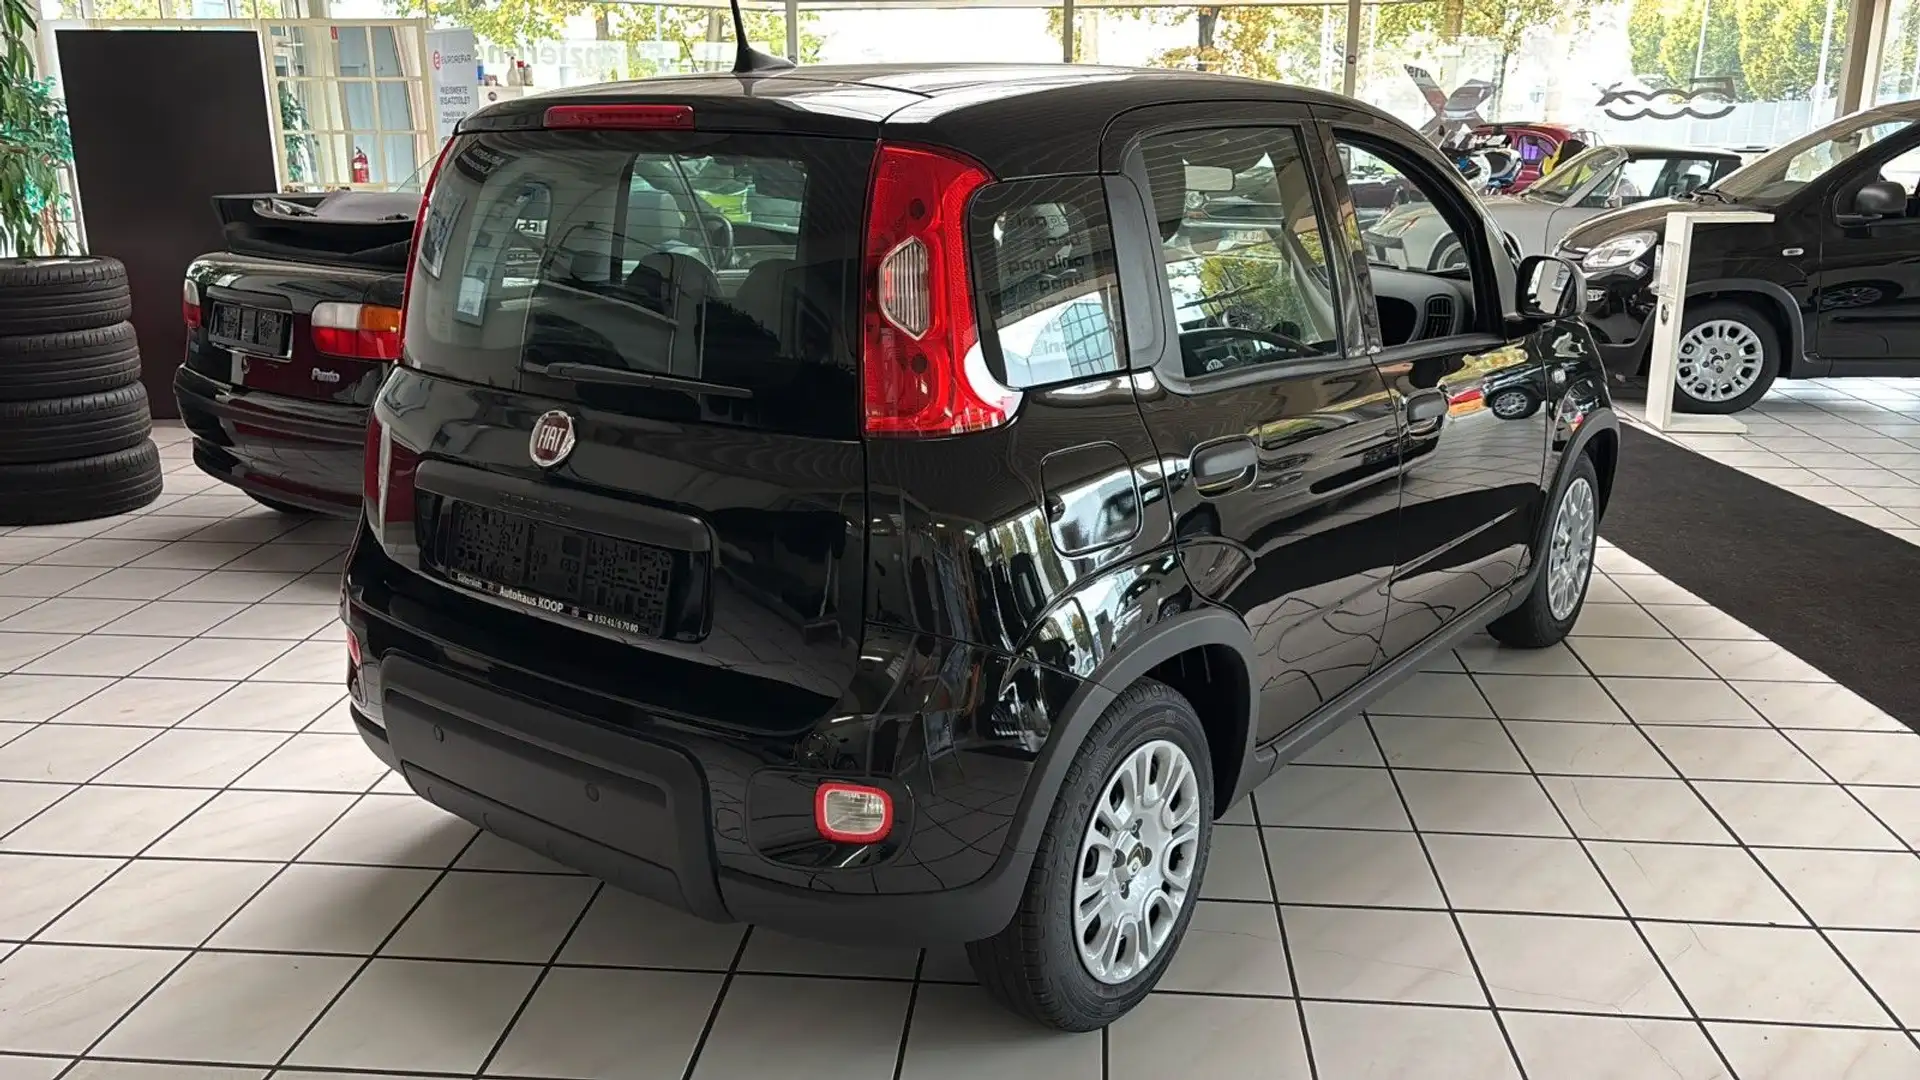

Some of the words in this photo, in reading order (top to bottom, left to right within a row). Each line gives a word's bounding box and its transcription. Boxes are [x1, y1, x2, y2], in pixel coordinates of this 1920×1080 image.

[311, 368, 340, 383] Punto
[537, 425, 566, 452] FIAT
[500, 585, 536, 606] Autohaus
[538, 597, 564, 613] KOOP
